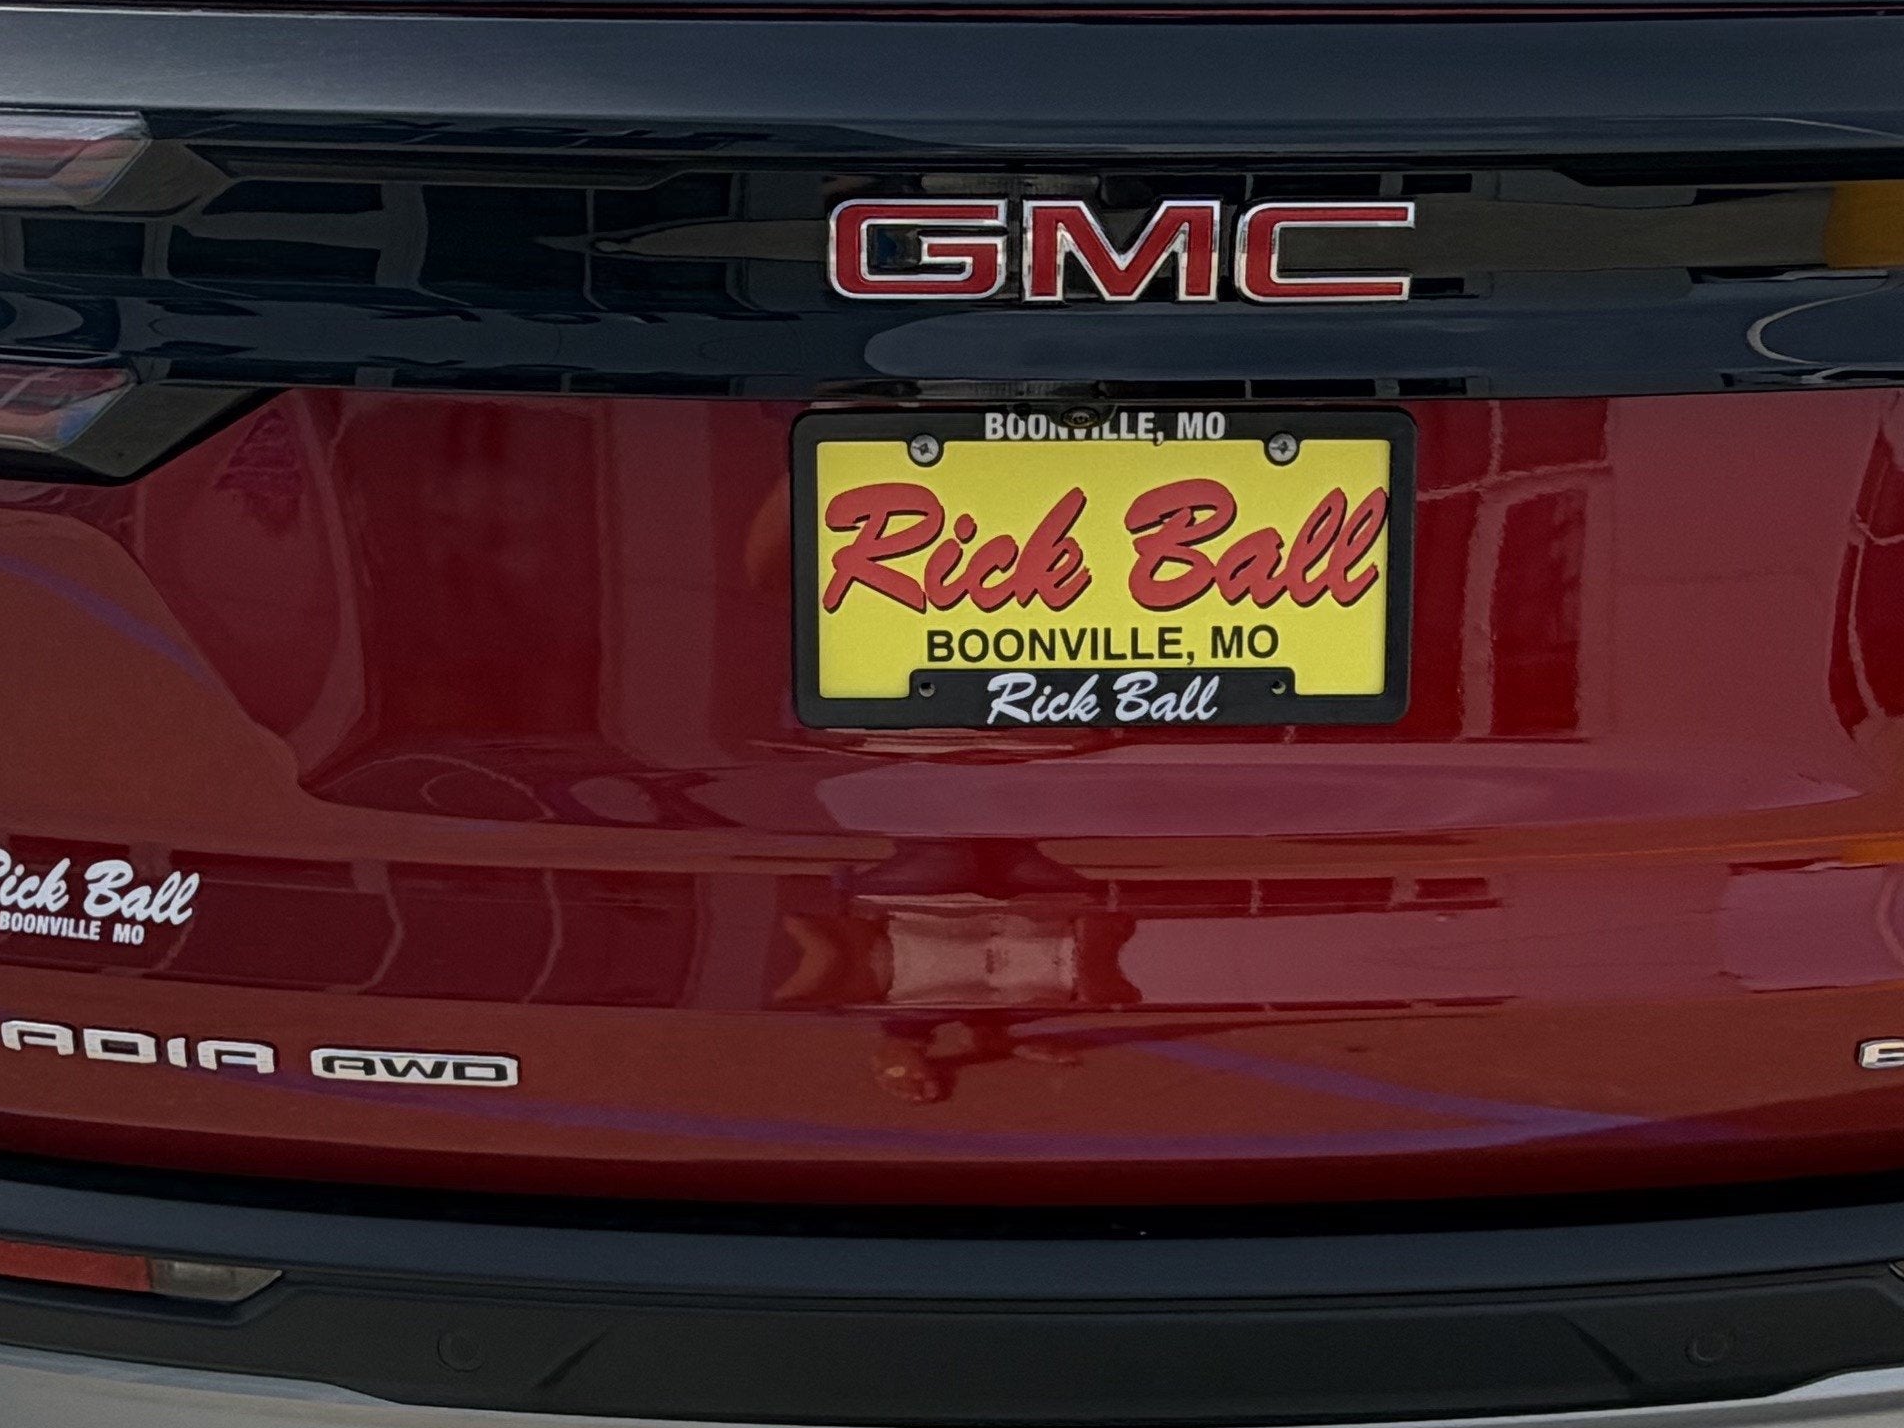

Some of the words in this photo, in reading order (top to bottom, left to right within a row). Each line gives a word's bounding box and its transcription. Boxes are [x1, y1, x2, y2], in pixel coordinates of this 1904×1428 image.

[827, 197, 1416, 303] GMC
[1176, 412, 1226, 440] MO
[822, 481, 1092, 614] Rick
[1125, 478, 1392, 612] Ball
[926, 626, 1195, 666] BOONVILLE,
[1211, 624, 1280, 660] MO
[986, 672, 1100, 726] Rick
[1112, 674, 1220, 723] Ball
[83, 859, 200, 926] Ball
[112, 923, 145, 946] MO
[319, 1054, 510, 1084] AWD
